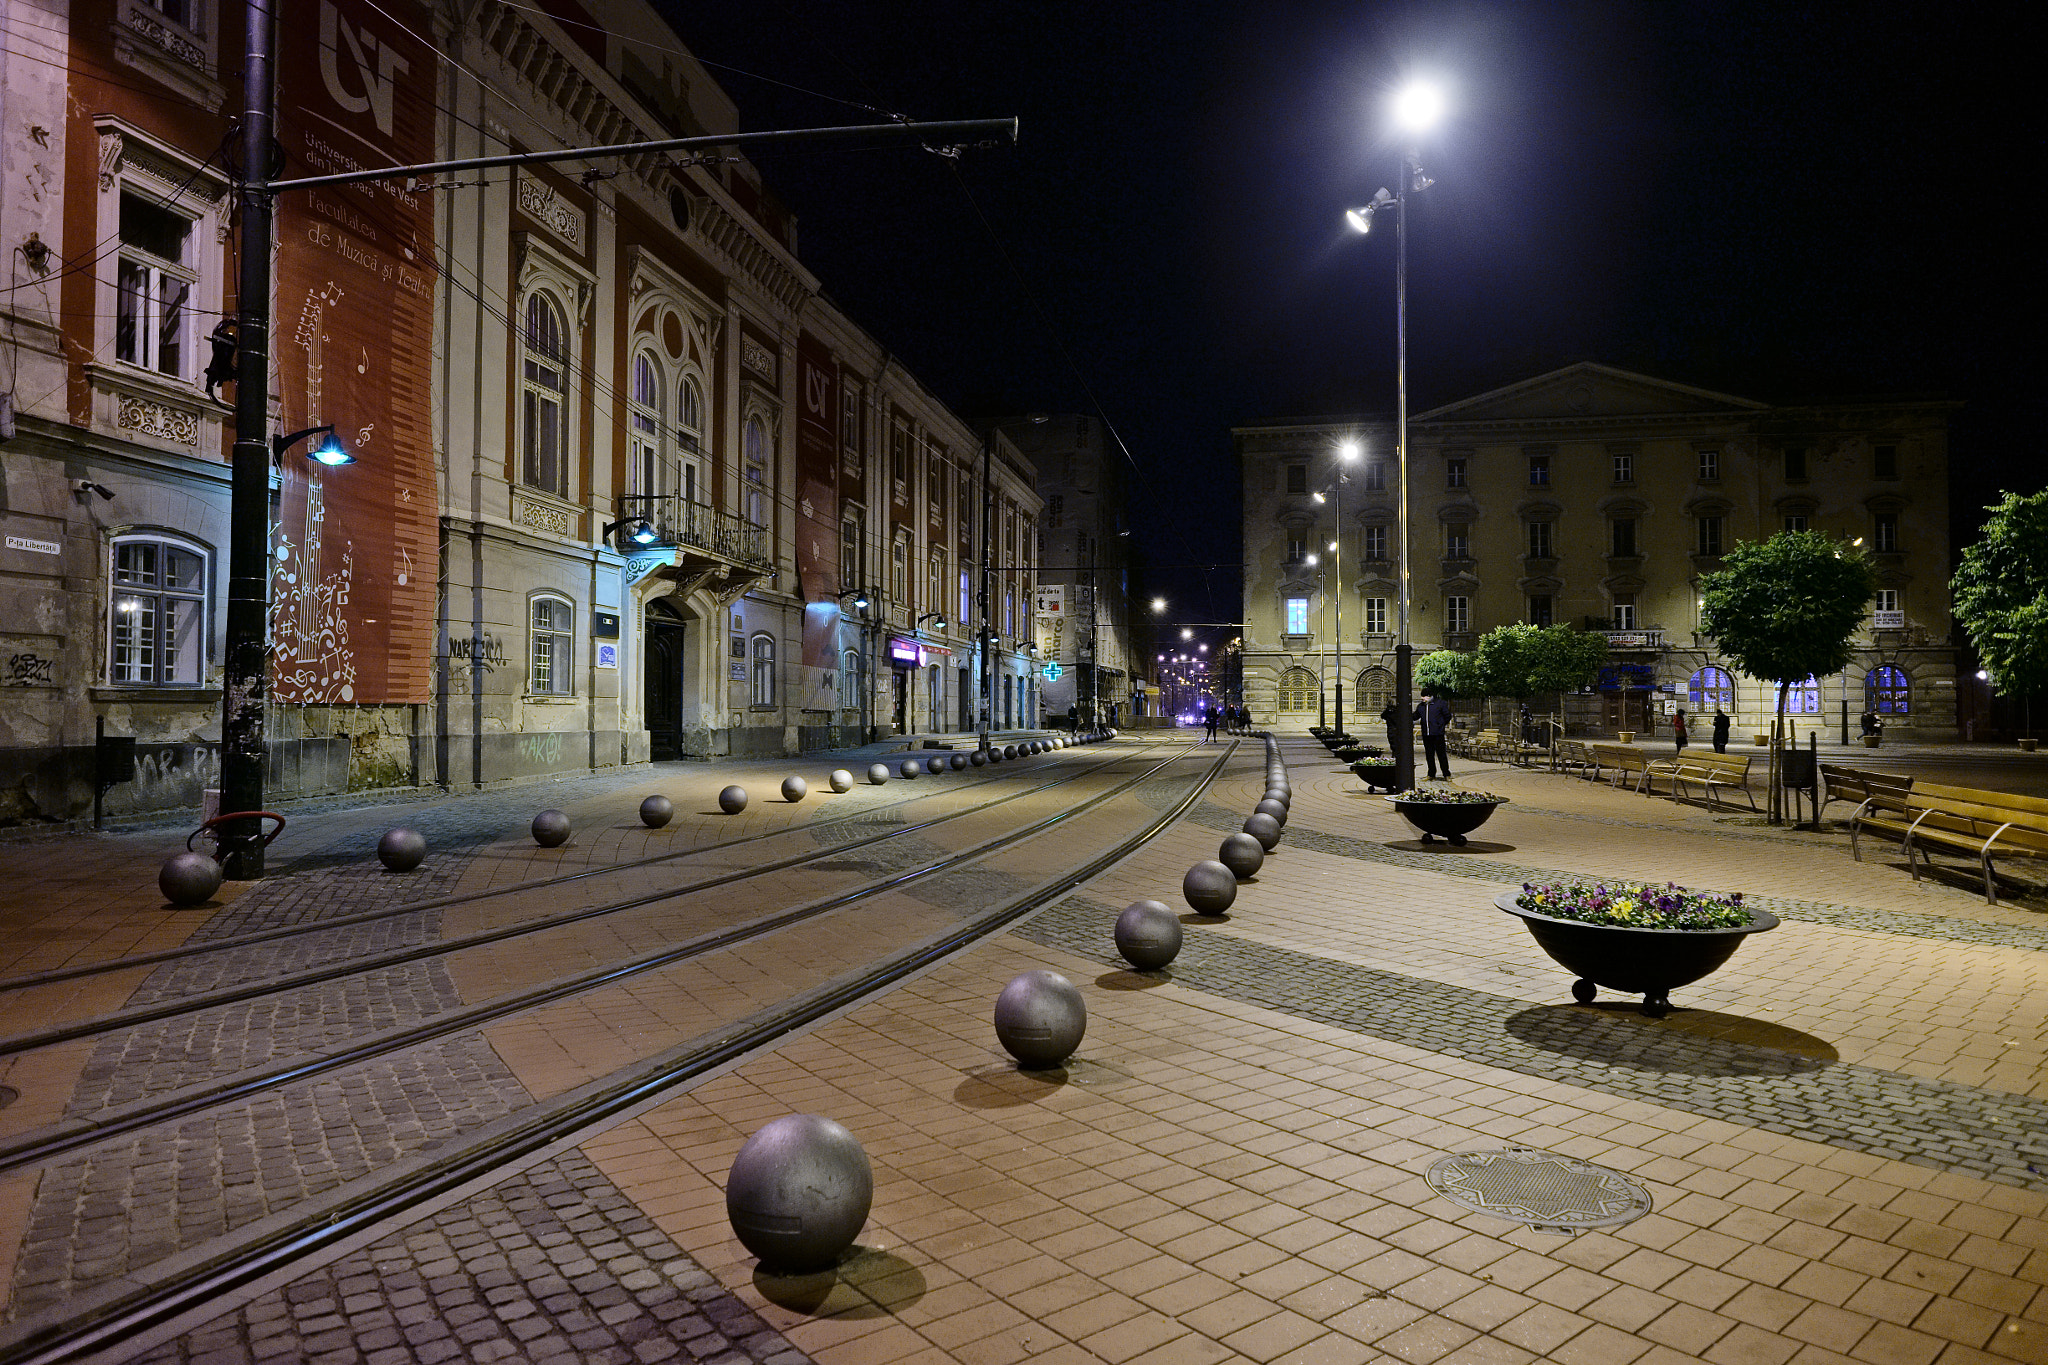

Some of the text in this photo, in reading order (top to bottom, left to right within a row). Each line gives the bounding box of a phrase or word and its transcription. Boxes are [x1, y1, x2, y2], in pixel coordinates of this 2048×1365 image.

[306, 151, 325, 169] din
[383, 179, 396, 198] de
[397, 186, 419, 212] Vest
[308, 224, 331, 248] de
[336, 234, 378, 272] Muzică
[1043, 637, 1052, 661] san
[1052, 618, 1064, 661] marco
